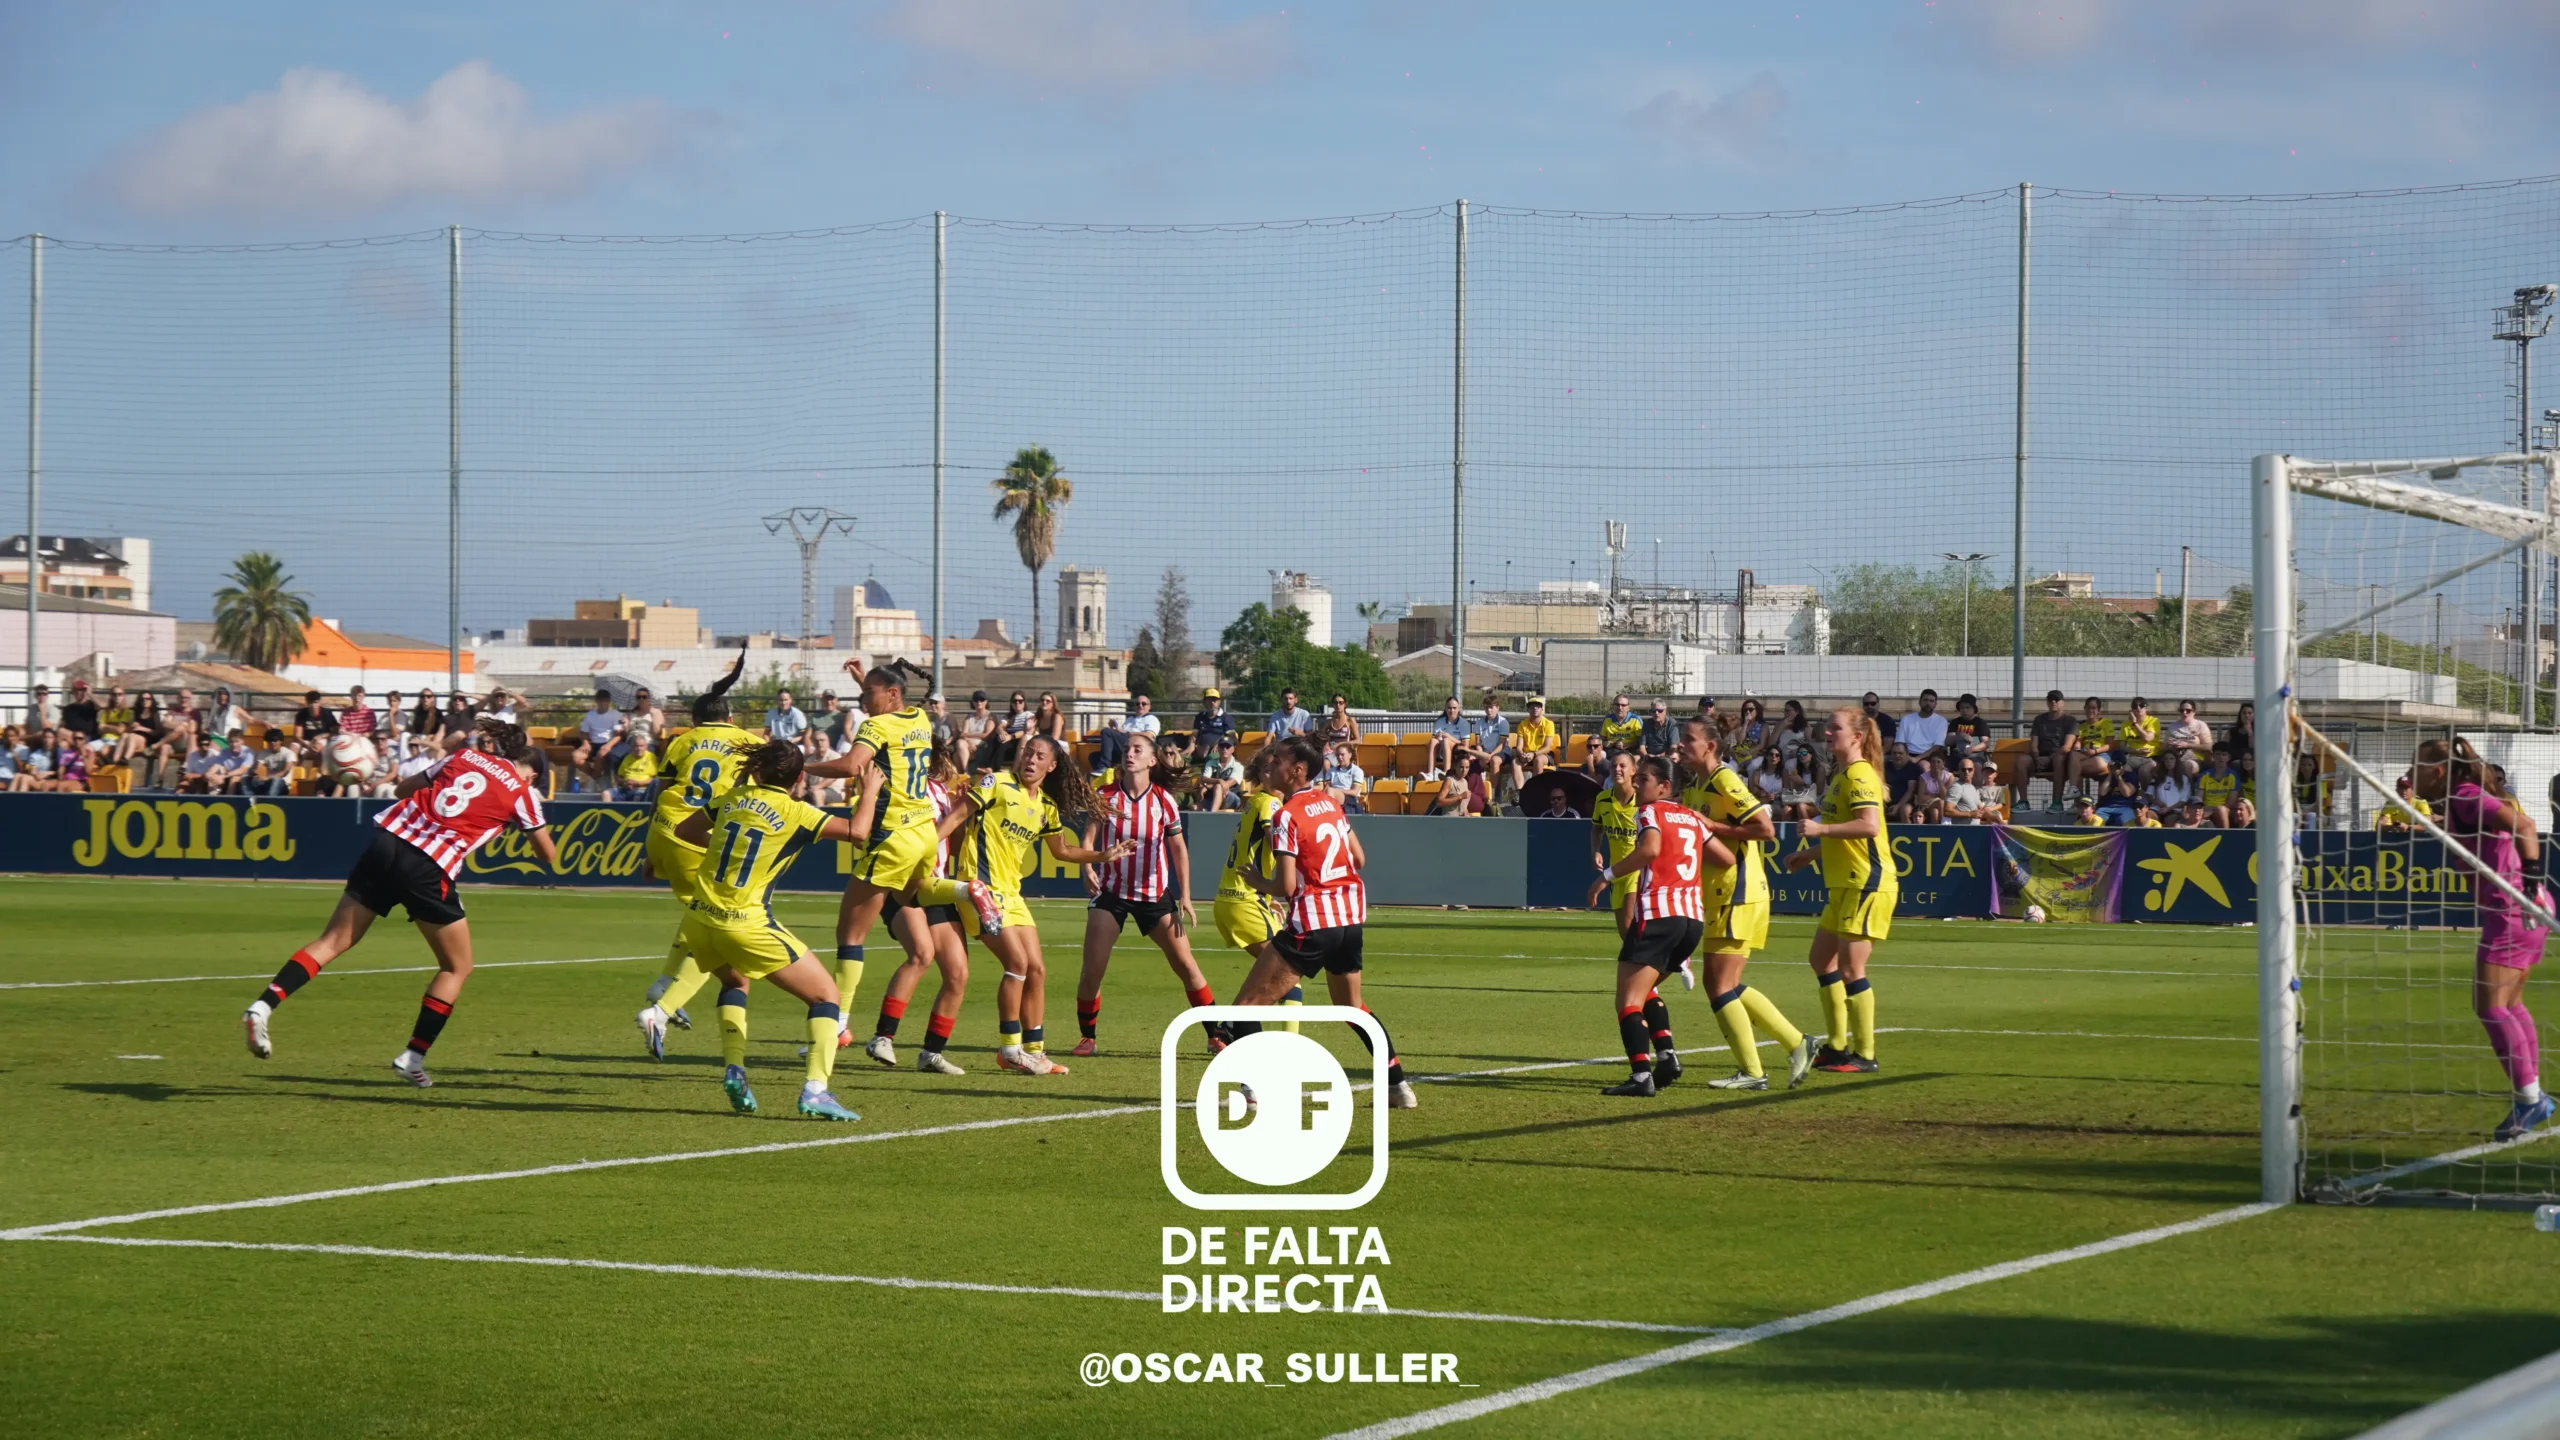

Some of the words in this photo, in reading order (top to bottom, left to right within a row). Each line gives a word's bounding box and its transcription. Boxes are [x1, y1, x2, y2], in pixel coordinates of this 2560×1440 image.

[460, 749, 522, 793] BORDAGARAY
[434, 771, 488, 818] 8
[737, 797, 786, 833] MEDINA
[714, 820, 766, 889] 11
[1676, 827, 1699, 882] 3
[1916, 892, 1938, 905] CF
